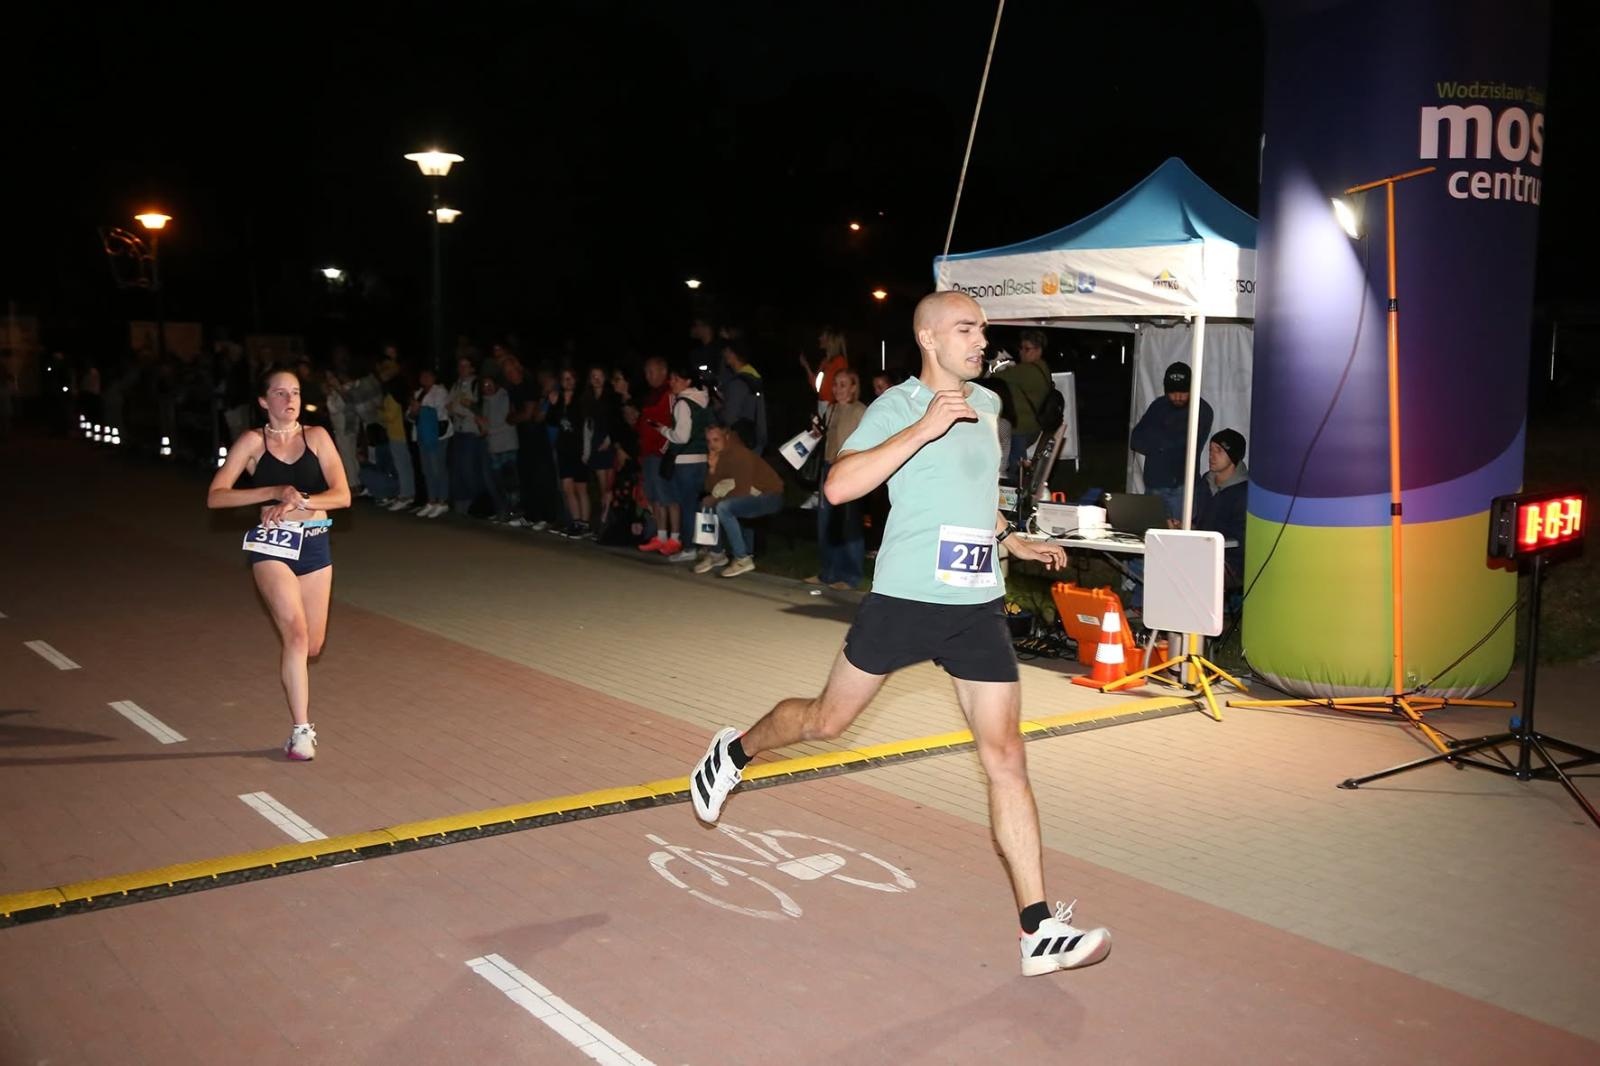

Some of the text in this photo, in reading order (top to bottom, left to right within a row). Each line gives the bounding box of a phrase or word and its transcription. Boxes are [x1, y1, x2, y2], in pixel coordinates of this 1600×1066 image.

[1420, 104, 1544, 166] mos
[255, 529, 293, 547] 312
[950, 544, 990, 570] 217
